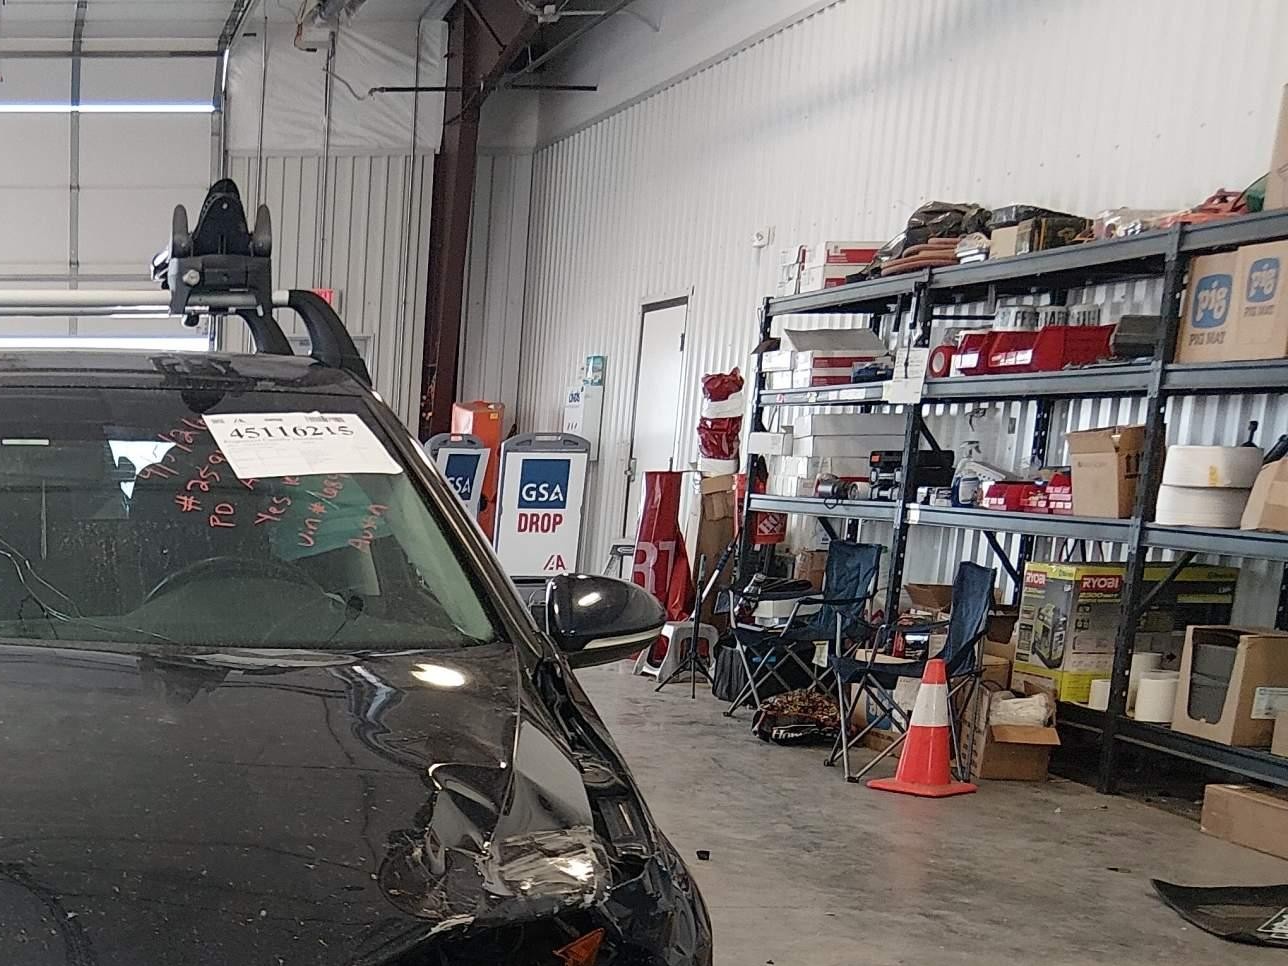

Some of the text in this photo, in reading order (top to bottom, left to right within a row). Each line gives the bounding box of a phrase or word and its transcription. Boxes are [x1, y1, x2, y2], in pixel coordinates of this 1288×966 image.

[1189, 333, 1205, 346] PIG
[229, 425, 355, 440] 45116215
[521, 483, 564, 502] GSA
[209, 503, 237, 527] PD
[254, 496, 292, 526] Yes
[517, 512, 564, 534] DROP
[1025, 571, 1046, 585] RYOBI
[1083, 576, 1119, 589] RYOBI
